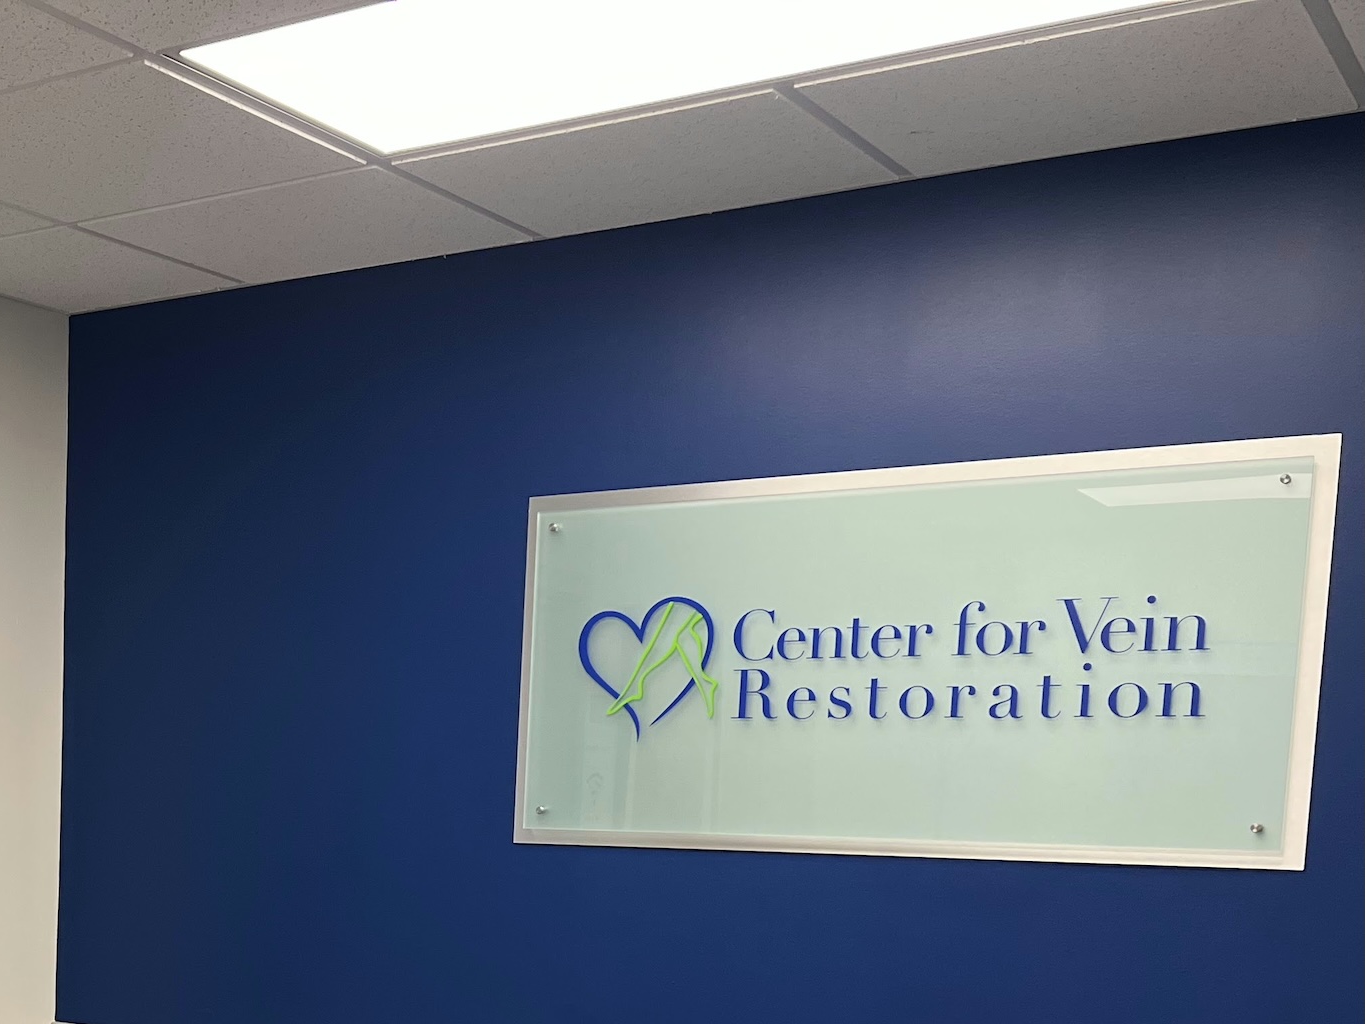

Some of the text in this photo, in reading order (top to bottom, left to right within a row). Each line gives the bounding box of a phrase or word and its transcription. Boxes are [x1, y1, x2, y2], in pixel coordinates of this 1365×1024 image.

[733, 596, 1211, 662] Center for Vein
[730, 662, 1207, 723] Restoration
